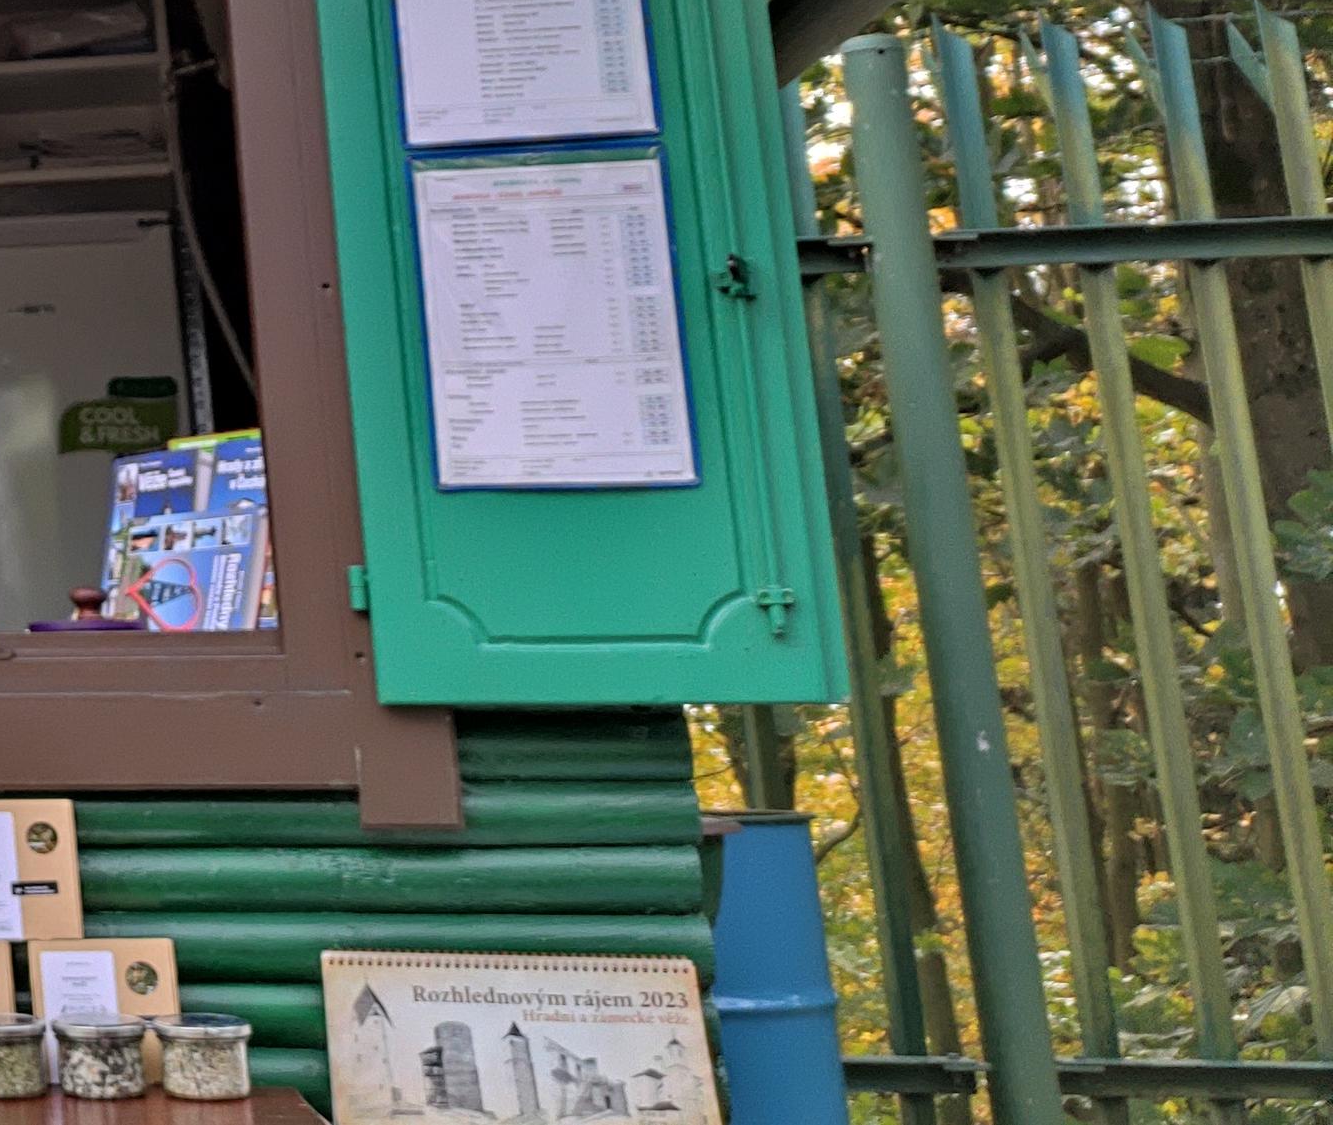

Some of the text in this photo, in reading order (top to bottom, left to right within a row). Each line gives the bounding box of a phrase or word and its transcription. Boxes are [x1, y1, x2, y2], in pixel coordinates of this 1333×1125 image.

[79, 407, 137, 425] COOL
[412, 985, 689, 1011] Rozhlednovým rájem 2023
